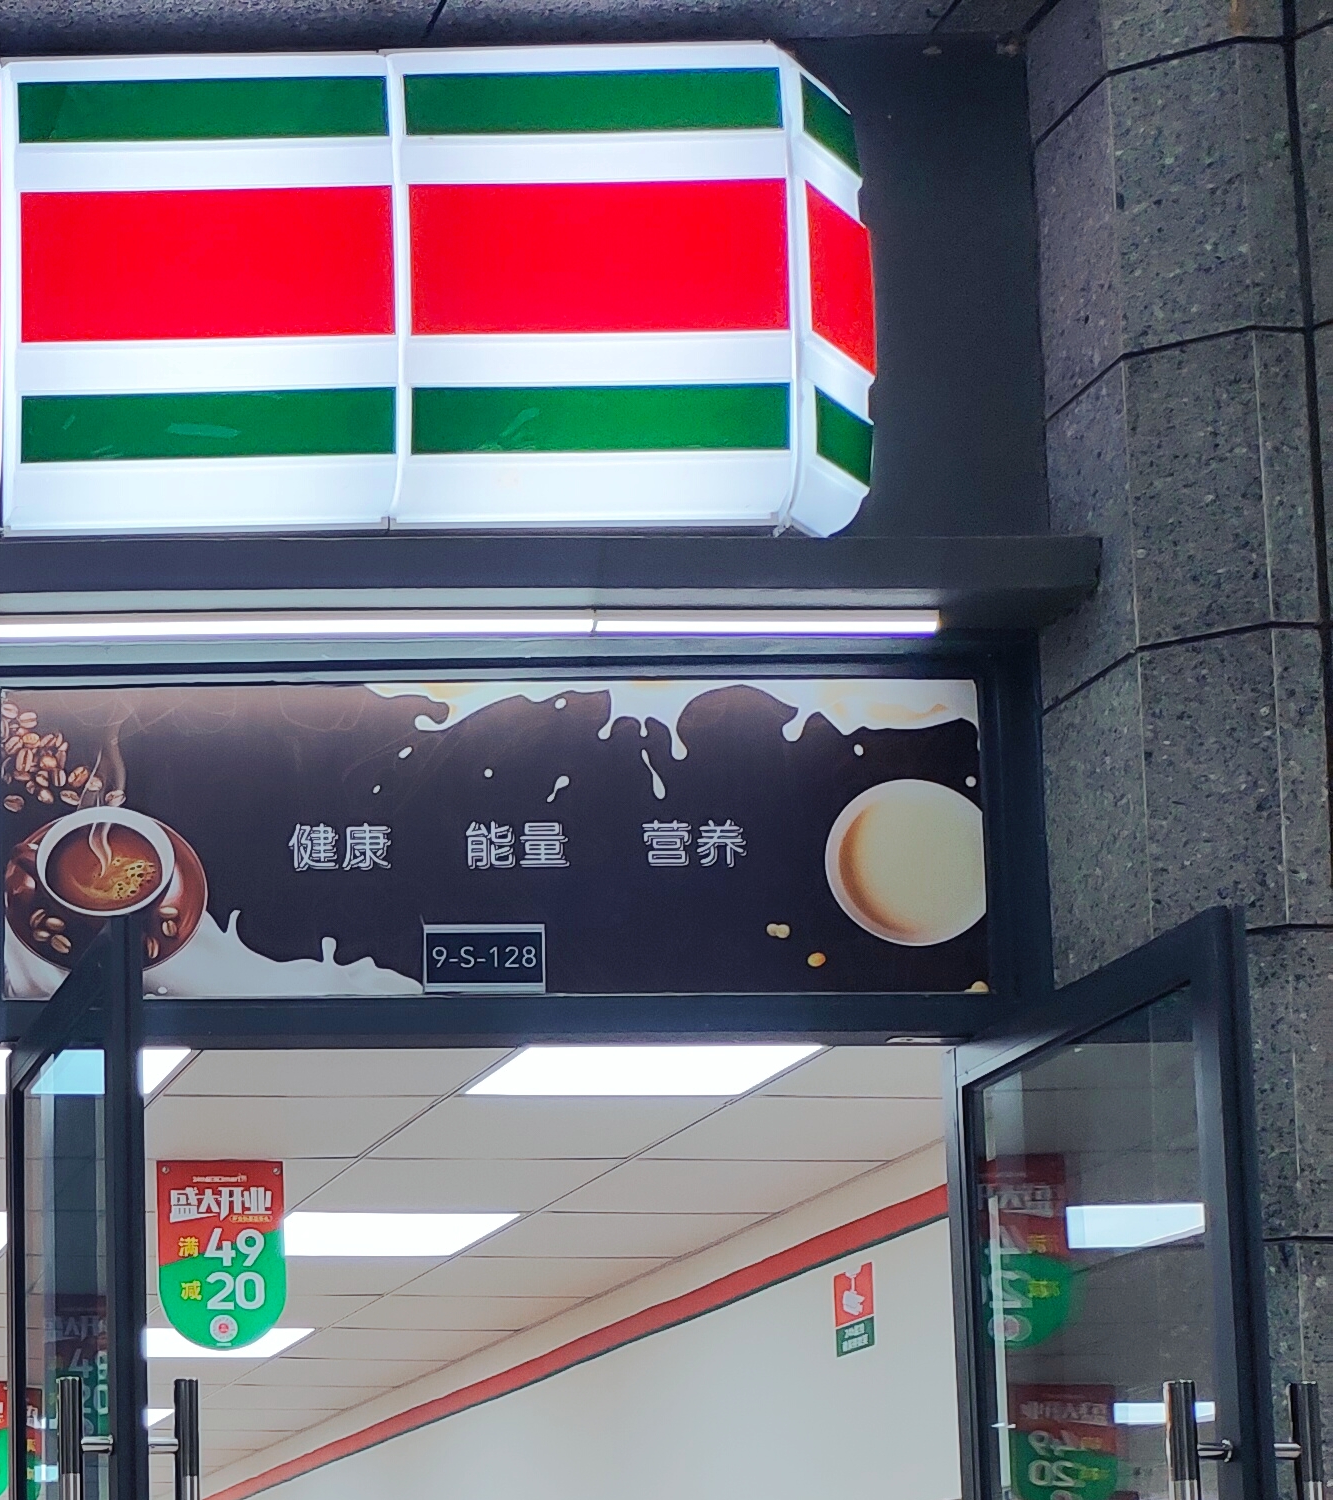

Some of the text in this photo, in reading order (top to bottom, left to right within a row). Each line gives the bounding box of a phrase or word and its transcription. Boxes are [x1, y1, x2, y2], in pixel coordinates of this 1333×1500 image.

[289, 819, 747, 870] 健康 能量 营养
[431, 945, 538, 970] 9-S-128
[170, 1187, 272, 1223] 盛大开业
